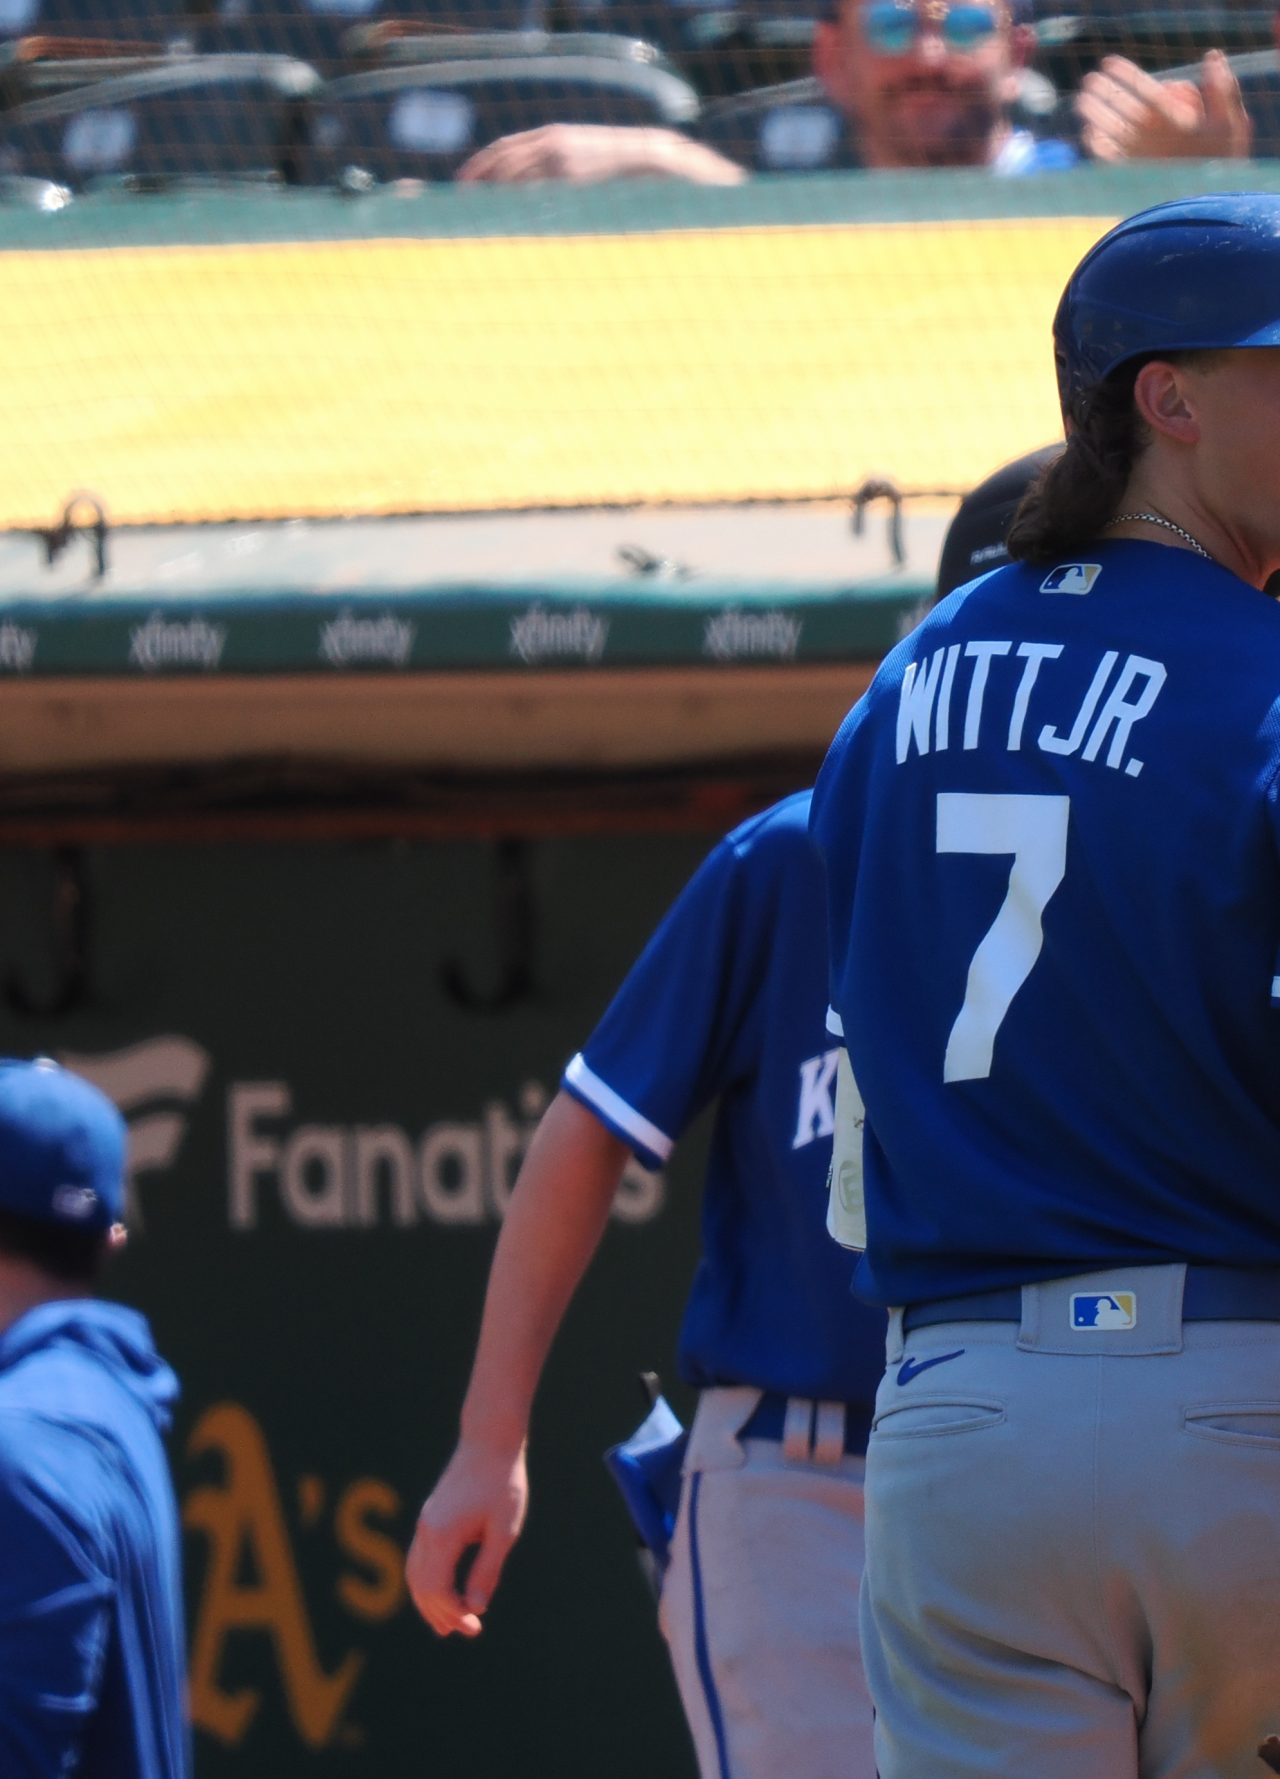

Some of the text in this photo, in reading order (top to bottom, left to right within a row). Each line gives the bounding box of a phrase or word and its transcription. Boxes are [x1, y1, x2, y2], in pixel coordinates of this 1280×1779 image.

[895, 641, 1168, 778] WITT JR.
[936, 792, 1071, 1083] 7
[184, 1399, 407, 1750] A's
